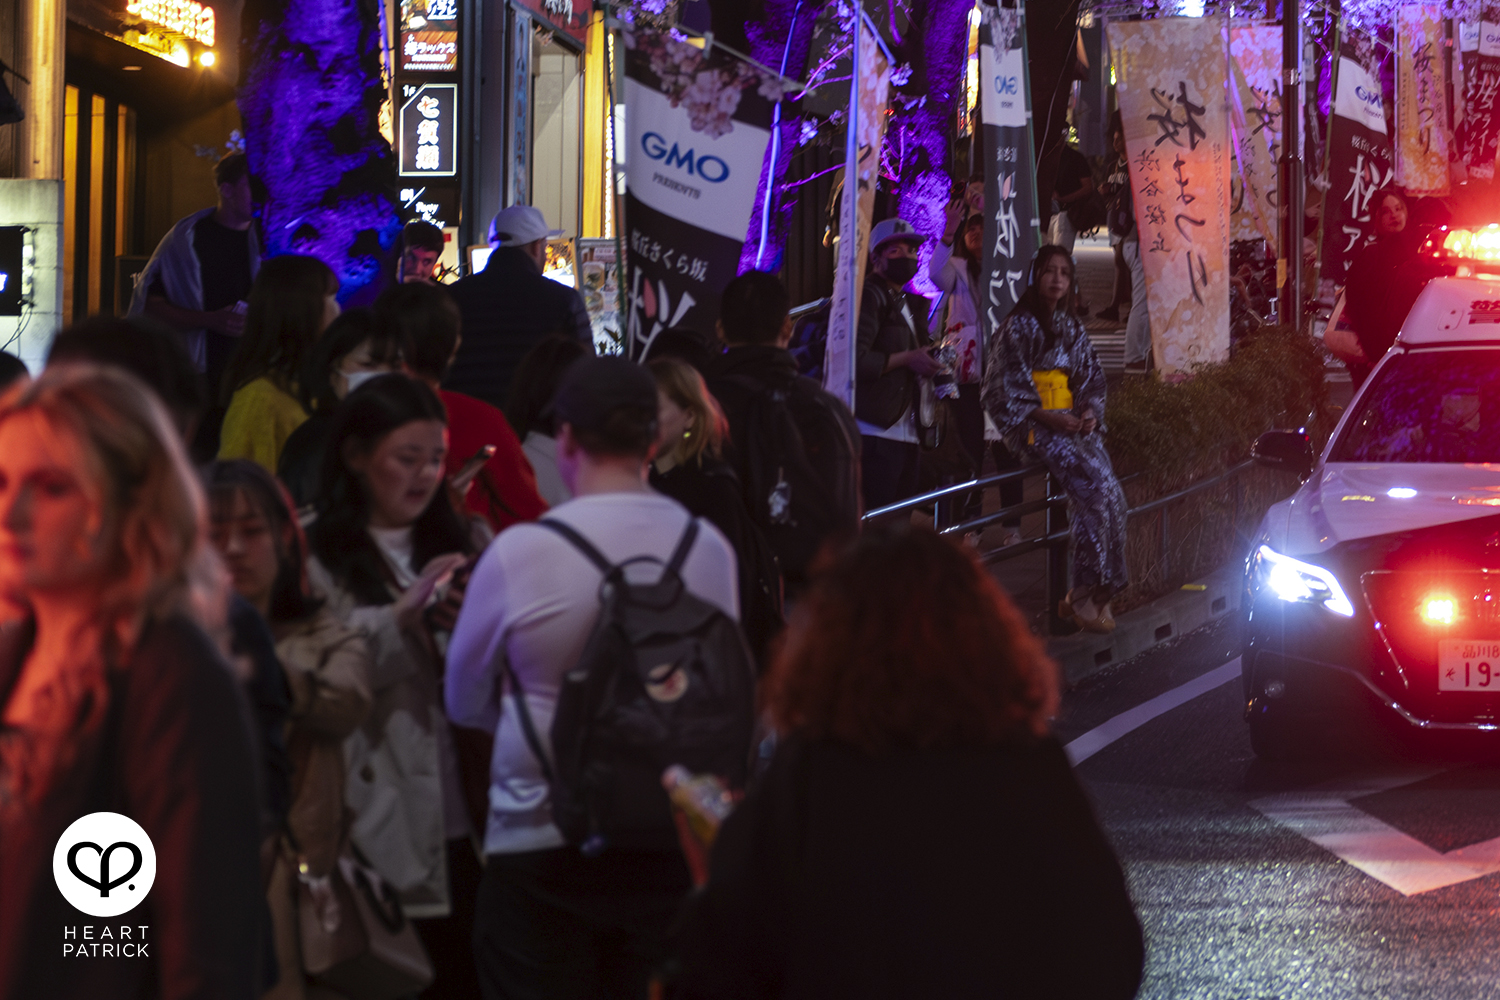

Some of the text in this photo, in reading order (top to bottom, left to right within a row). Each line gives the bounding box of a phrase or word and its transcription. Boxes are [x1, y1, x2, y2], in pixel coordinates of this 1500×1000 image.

[1354, 85, 1383, 109] GM
[1413, 42, 1435, 156] 桜まつり
[641, 132, 730, 183] GMO
